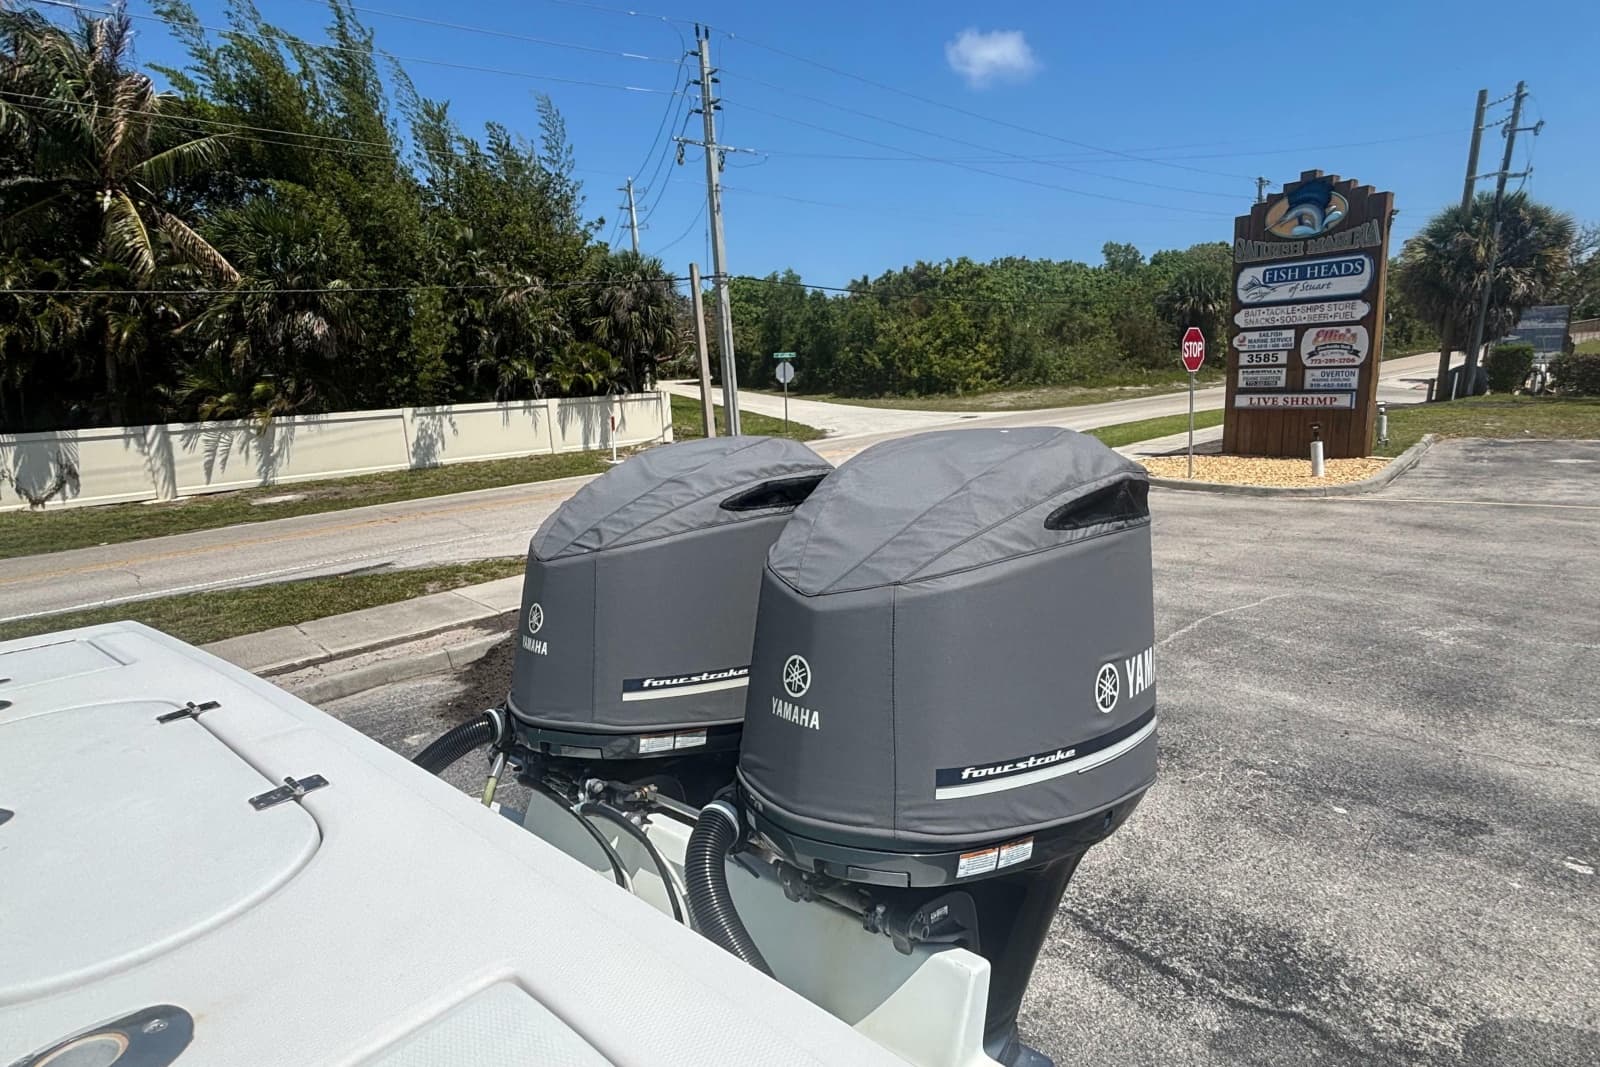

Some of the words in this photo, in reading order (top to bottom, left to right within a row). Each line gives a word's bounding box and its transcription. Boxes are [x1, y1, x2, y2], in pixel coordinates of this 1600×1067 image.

[1265, 268, 1299, 283] FISH
[1307, 260, 1363, 278] HEADS
[1289, 284, 1299, 297] of
[1302, 281, 1332, 291] Stuart
[1327, 301, 1357, 312] STORE
[1333, 311, 1355, 320] FUEL
[1184, 341, 1203, 358] STOP
[1247, 353, 1279, 363] 3585
[1320, 370, 1356, 378] OVERTON
[1249, 398, 1279, 406] LIVE
[1284, 396, 1337, 406] SHRIMP
[522, 634, 548, 656] YAMAHA
[772, 696, 821, 731] YAMAHA
[961, 748, 1077, 780] fourstroke
